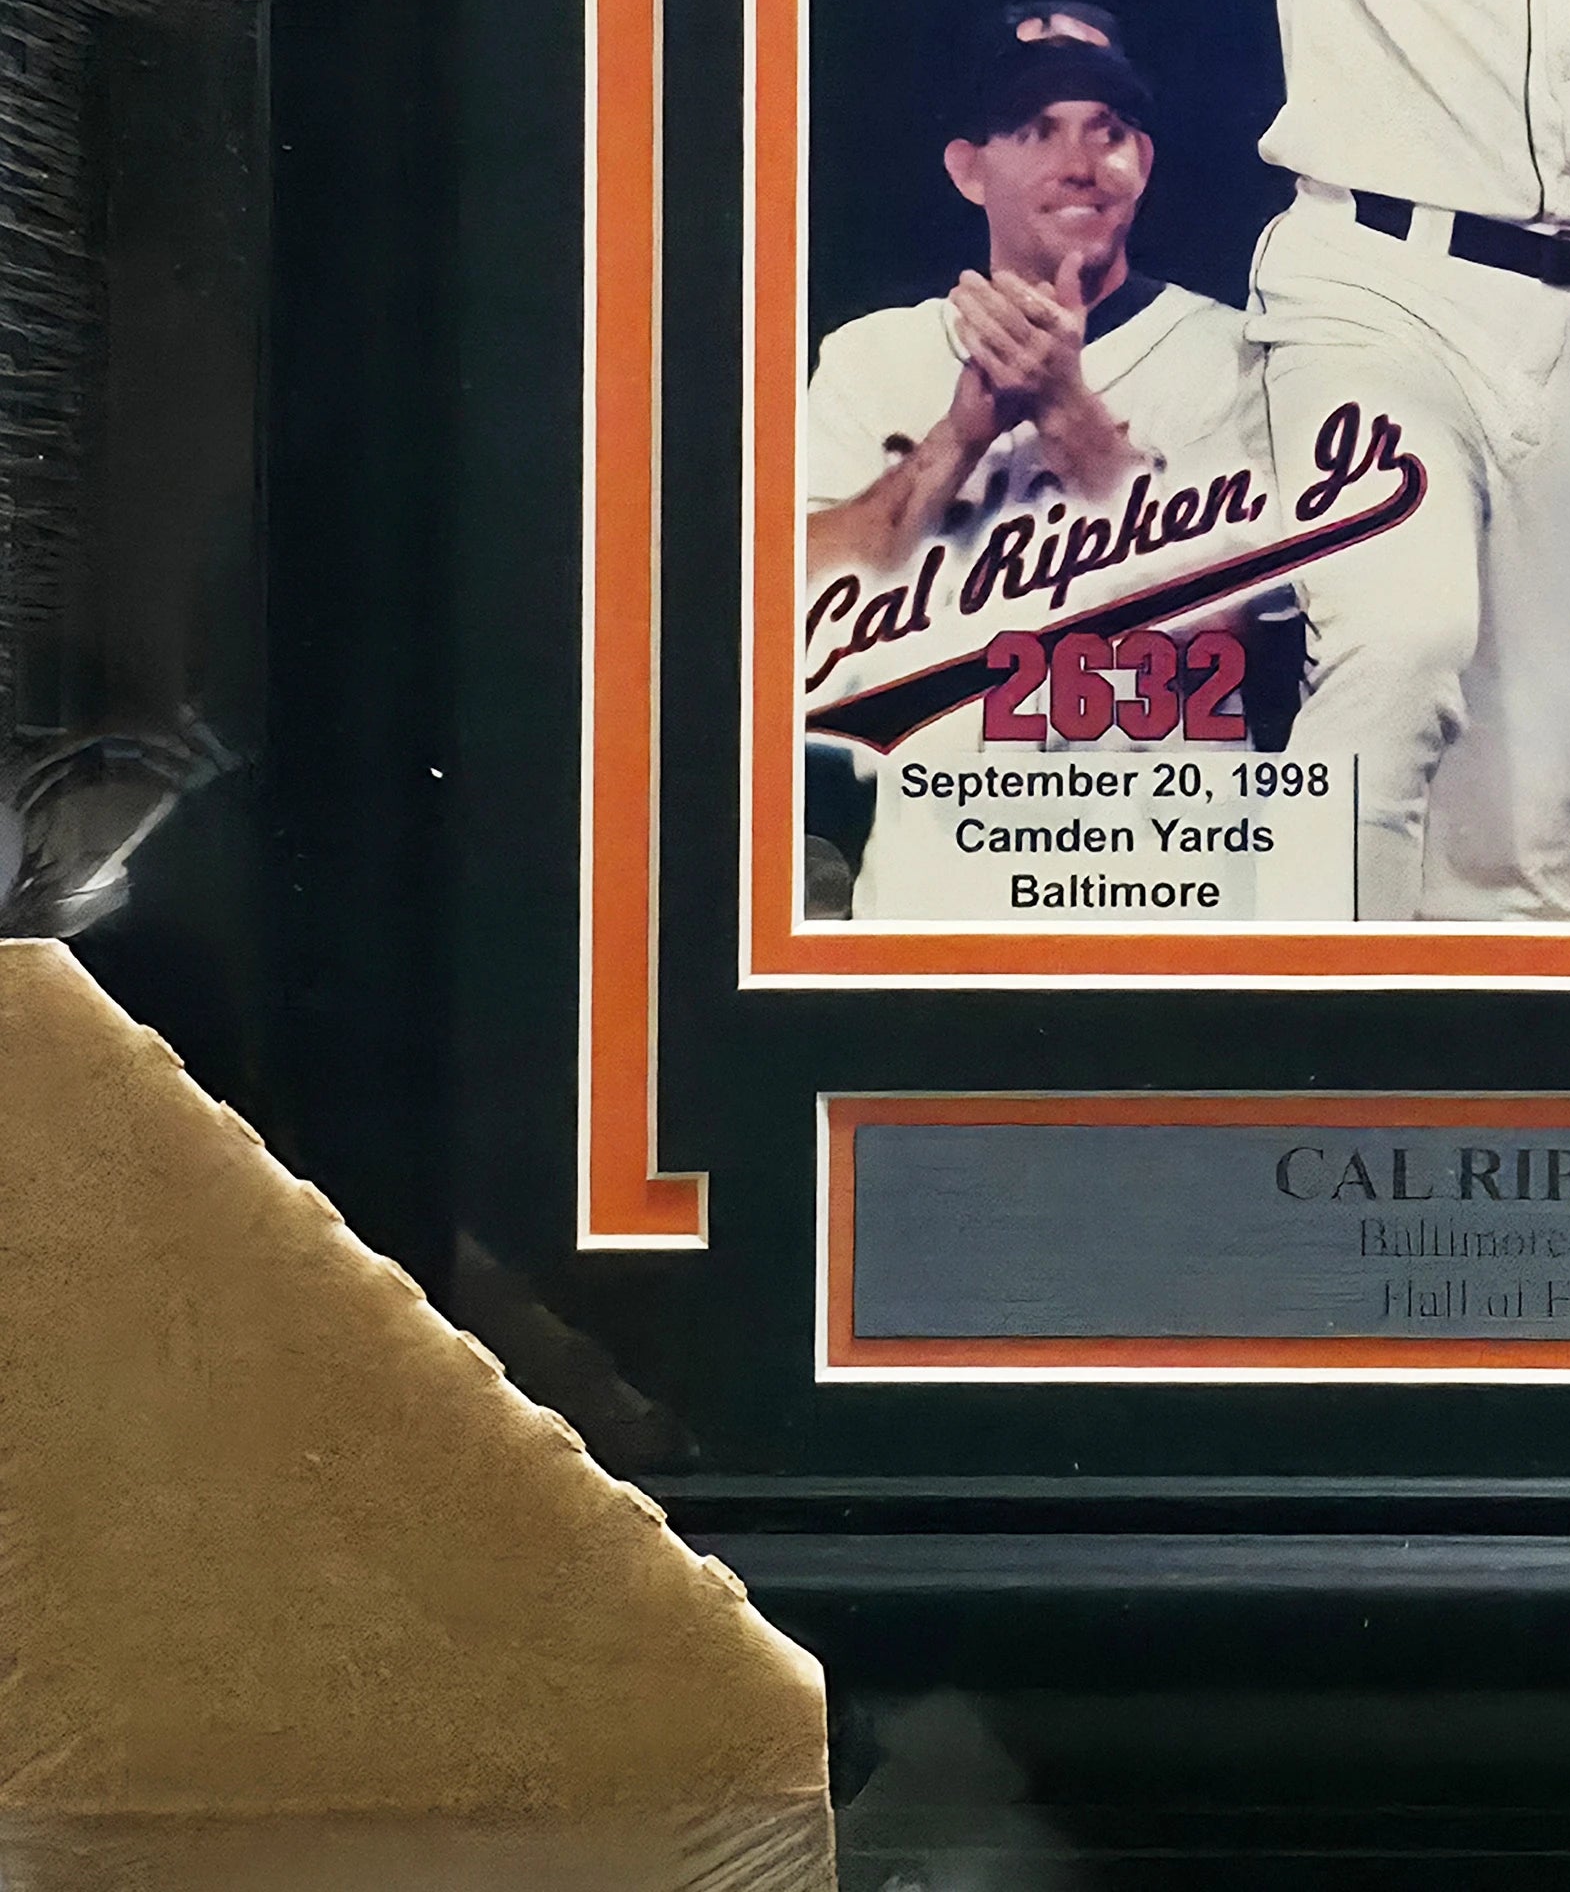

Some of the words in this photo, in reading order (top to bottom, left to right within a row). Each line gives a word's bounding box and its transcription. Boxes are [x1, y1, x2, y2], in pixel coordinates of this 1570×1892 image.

[805, 546, 946, 694] Cal
[959, 469, 1267, 610] Ripken,
[1296, 402, 1402, 521] Jr
[982, 630, 1247, 742] 2632
[901, 764, 1139, 806] September
[1153, 764, 1214, 804] 20,
[1233, 763, 1330, 799] 1998
[955, 818, 1135, 854] Camden
[1151, 818, 1275, 854] Yards
[1011, 874, 1221, 909] Baltimore
[1275, 1145, 1433, 1201] CAL
[1360, 1218, 1567, 1258] Baltimore
[1384, 1279, 1467, 1318] Hall
